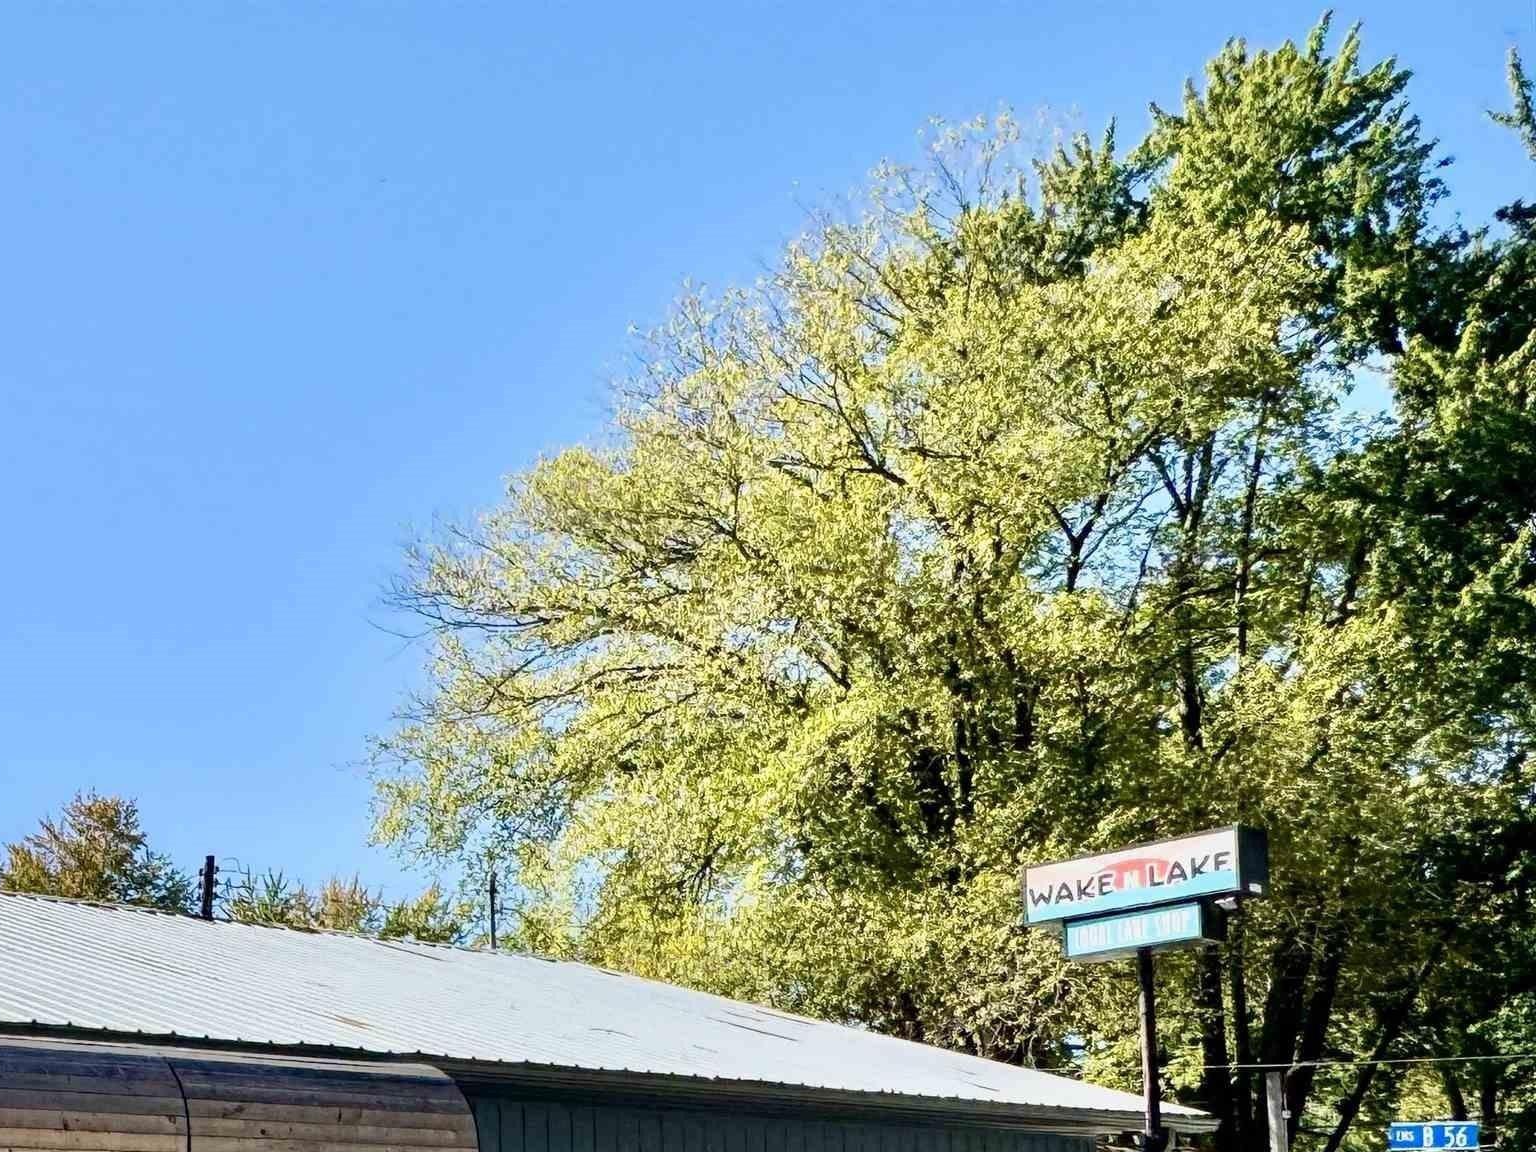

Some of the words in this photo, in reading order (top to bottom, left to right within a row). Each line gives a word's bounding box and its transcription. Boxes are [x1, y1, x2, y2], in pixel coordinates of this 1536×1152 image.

[1029, 873, 1114, 906] WAKE
[1148, 851, 1232, 887] LAKE
[1422, 1126, 1434, 1147] B
[1443, 1126, 1468, 1148] 56
